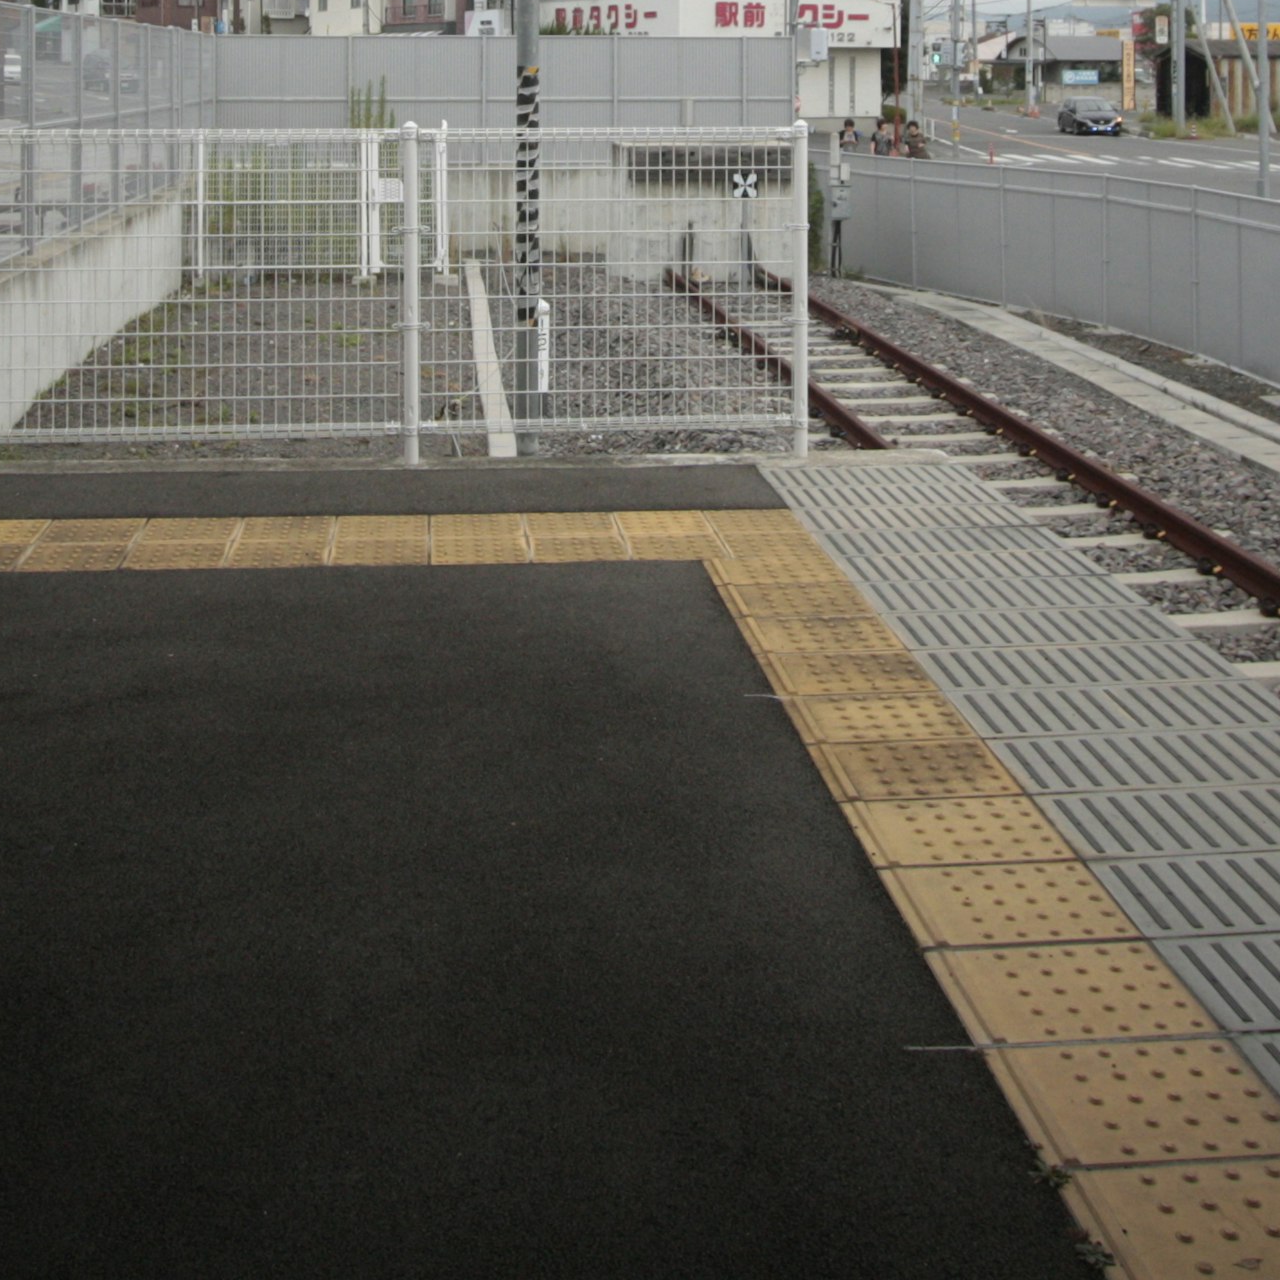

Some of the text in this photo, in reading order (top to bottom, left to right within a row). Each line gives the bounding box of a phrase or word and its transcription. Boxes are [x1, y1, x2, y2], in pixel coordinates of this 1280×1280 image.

[714, 1, 870, 29] 駅前クシー
